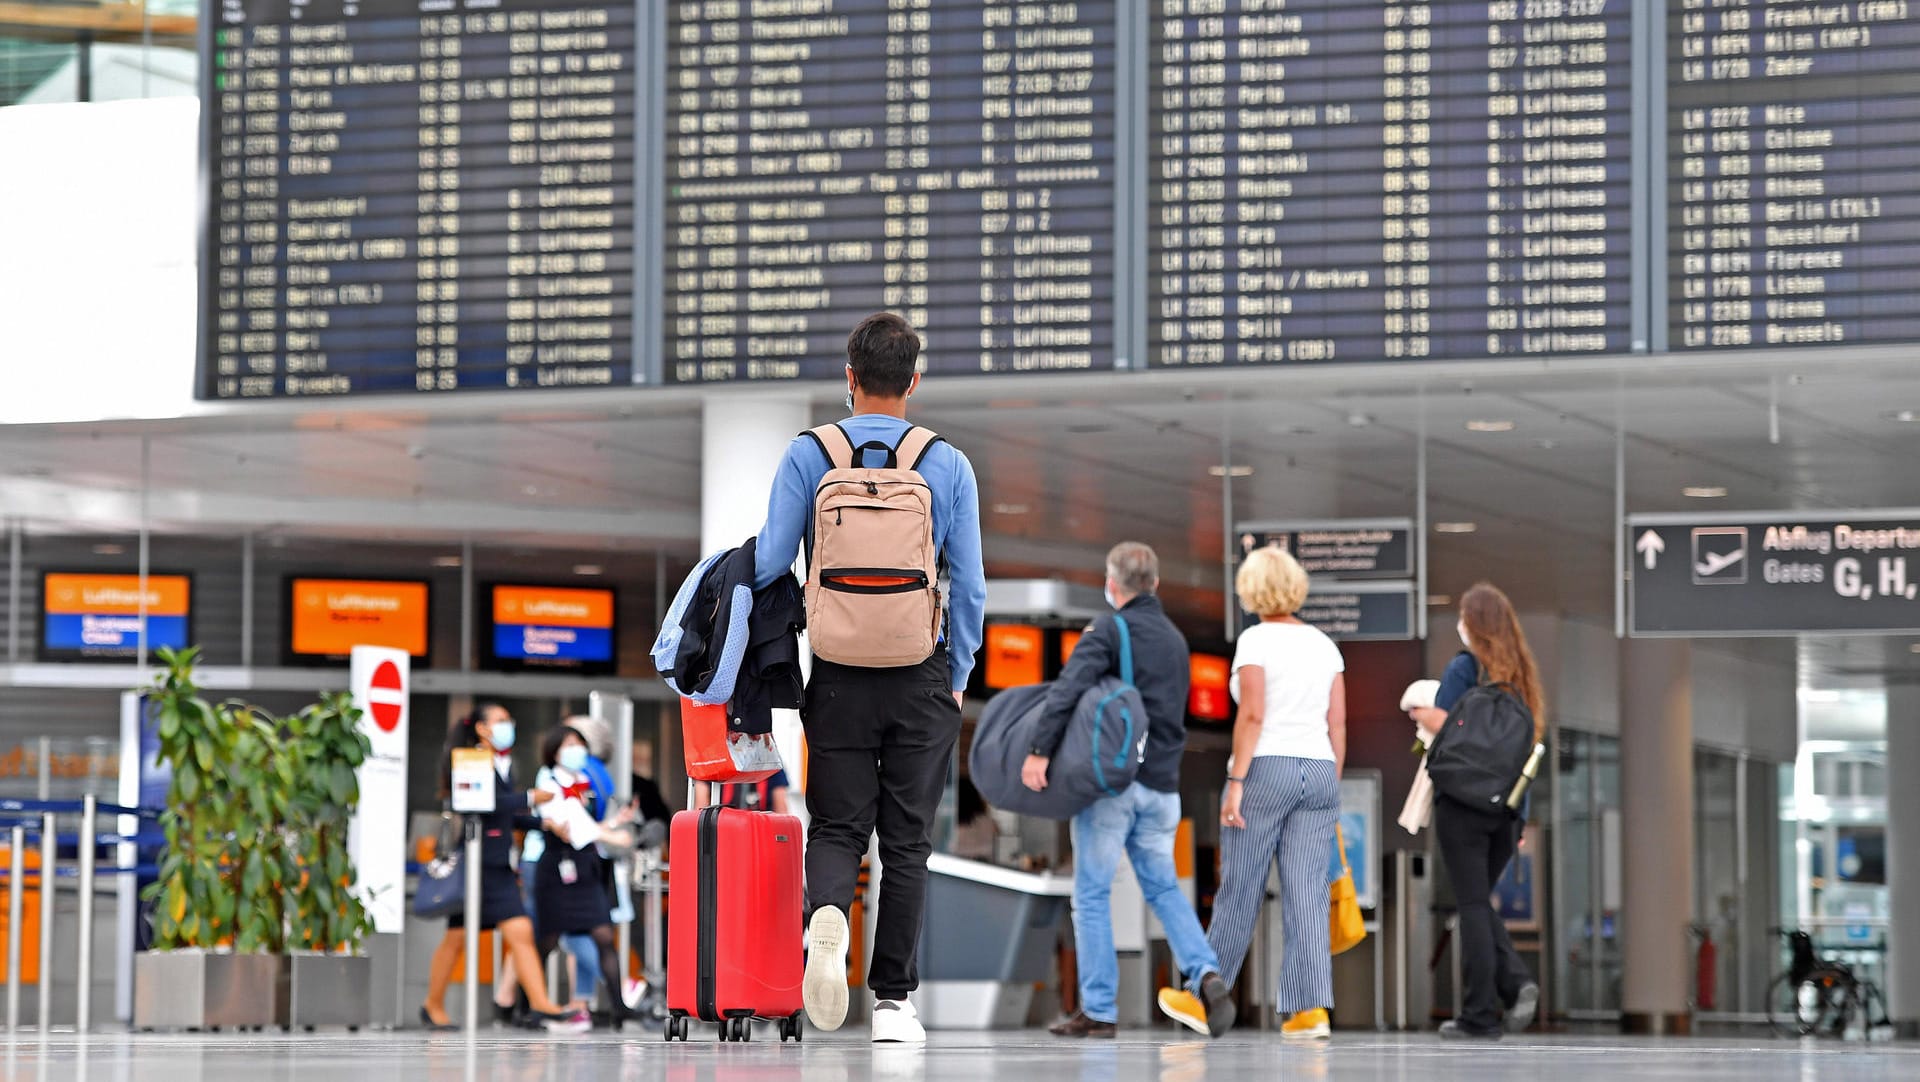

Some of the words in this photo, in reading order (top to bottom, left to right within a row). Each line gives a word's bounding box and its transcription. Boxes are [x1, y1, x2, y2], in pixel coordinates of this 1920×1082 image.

[1765, 6, 1849, 27] Frankfurt
[1765, 31, 1813, 51] Milan
[1766, 201, 1824, 221] Berlin
[1766, 249, 1842, 271] Florence
[1766, 323, 1843, 344] Brussels
[1763, 525, 1831, 554] Abflug
[1763, 559, 1824, 584] Gates
[327, 593, 401, 611] Lufthansa
